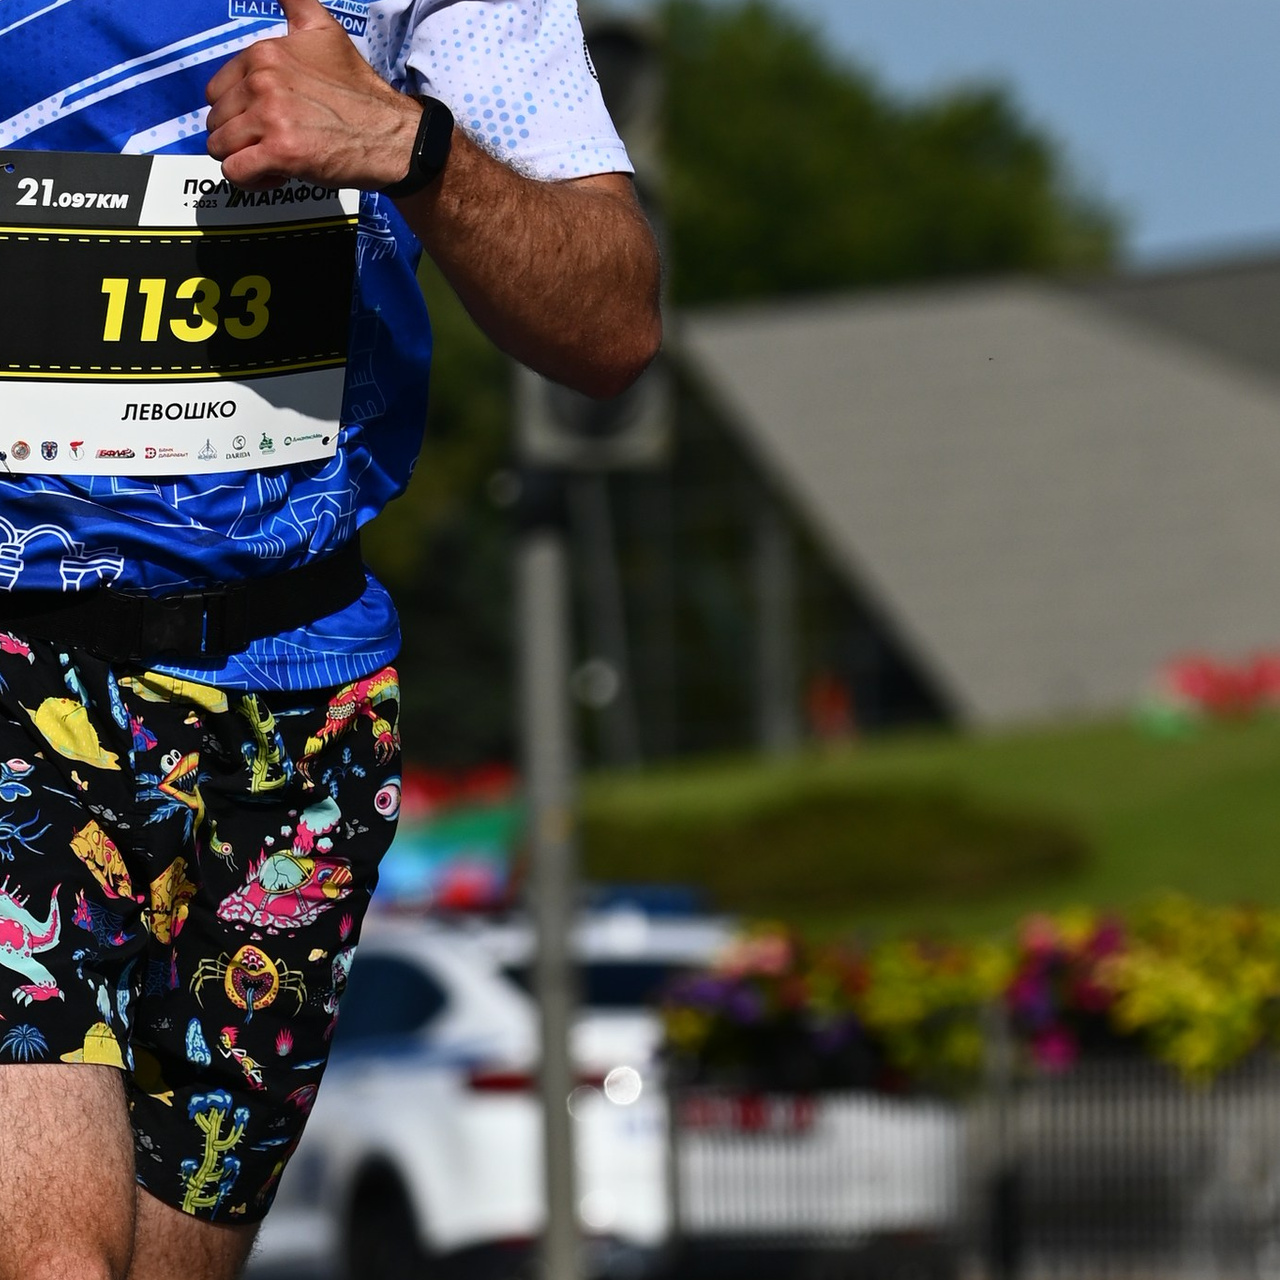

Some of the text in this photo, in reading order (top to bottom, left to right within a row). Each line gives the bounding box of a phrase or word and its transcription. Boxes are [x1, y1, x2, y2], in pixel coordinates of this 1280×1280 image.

[332, 0, 370, 15] MINSK
[192, 199, 218, 209] 2023
[232, 184, 339, 208] МАРАФОН
[101, 275, 271, 342] 1133
[121, 400, 237, 421] ЛЕВОШКО
